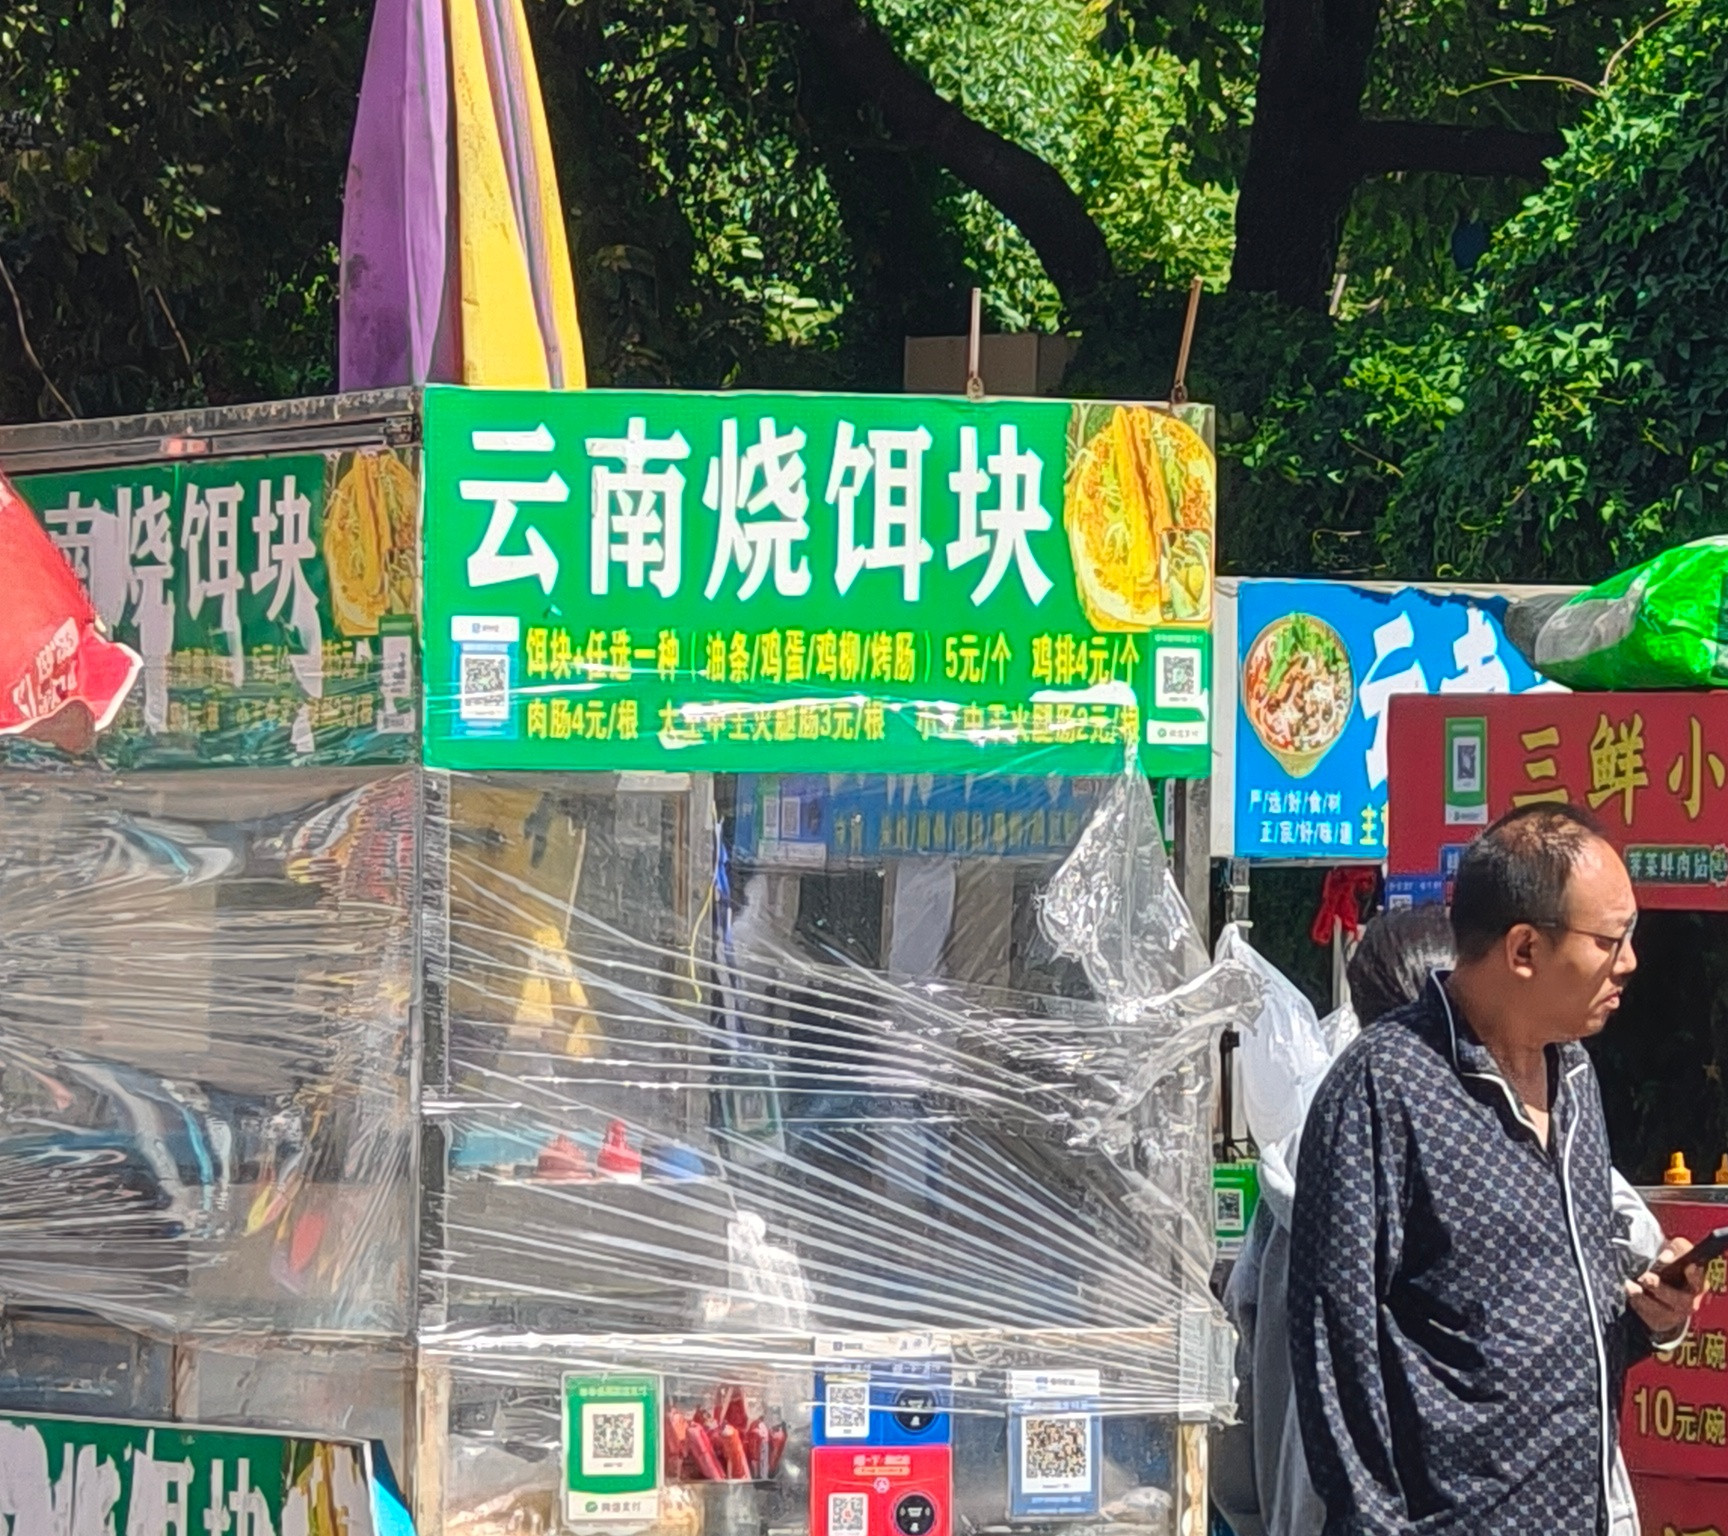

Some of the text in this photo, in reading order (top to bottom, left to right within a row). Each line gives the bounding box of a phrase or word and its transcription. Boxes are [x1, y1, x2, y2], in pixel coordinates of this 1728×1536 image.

[458, 416, 1055, 606] 云南烧饵块
[1633, 1386, 1728, 1446] 10元/碗
